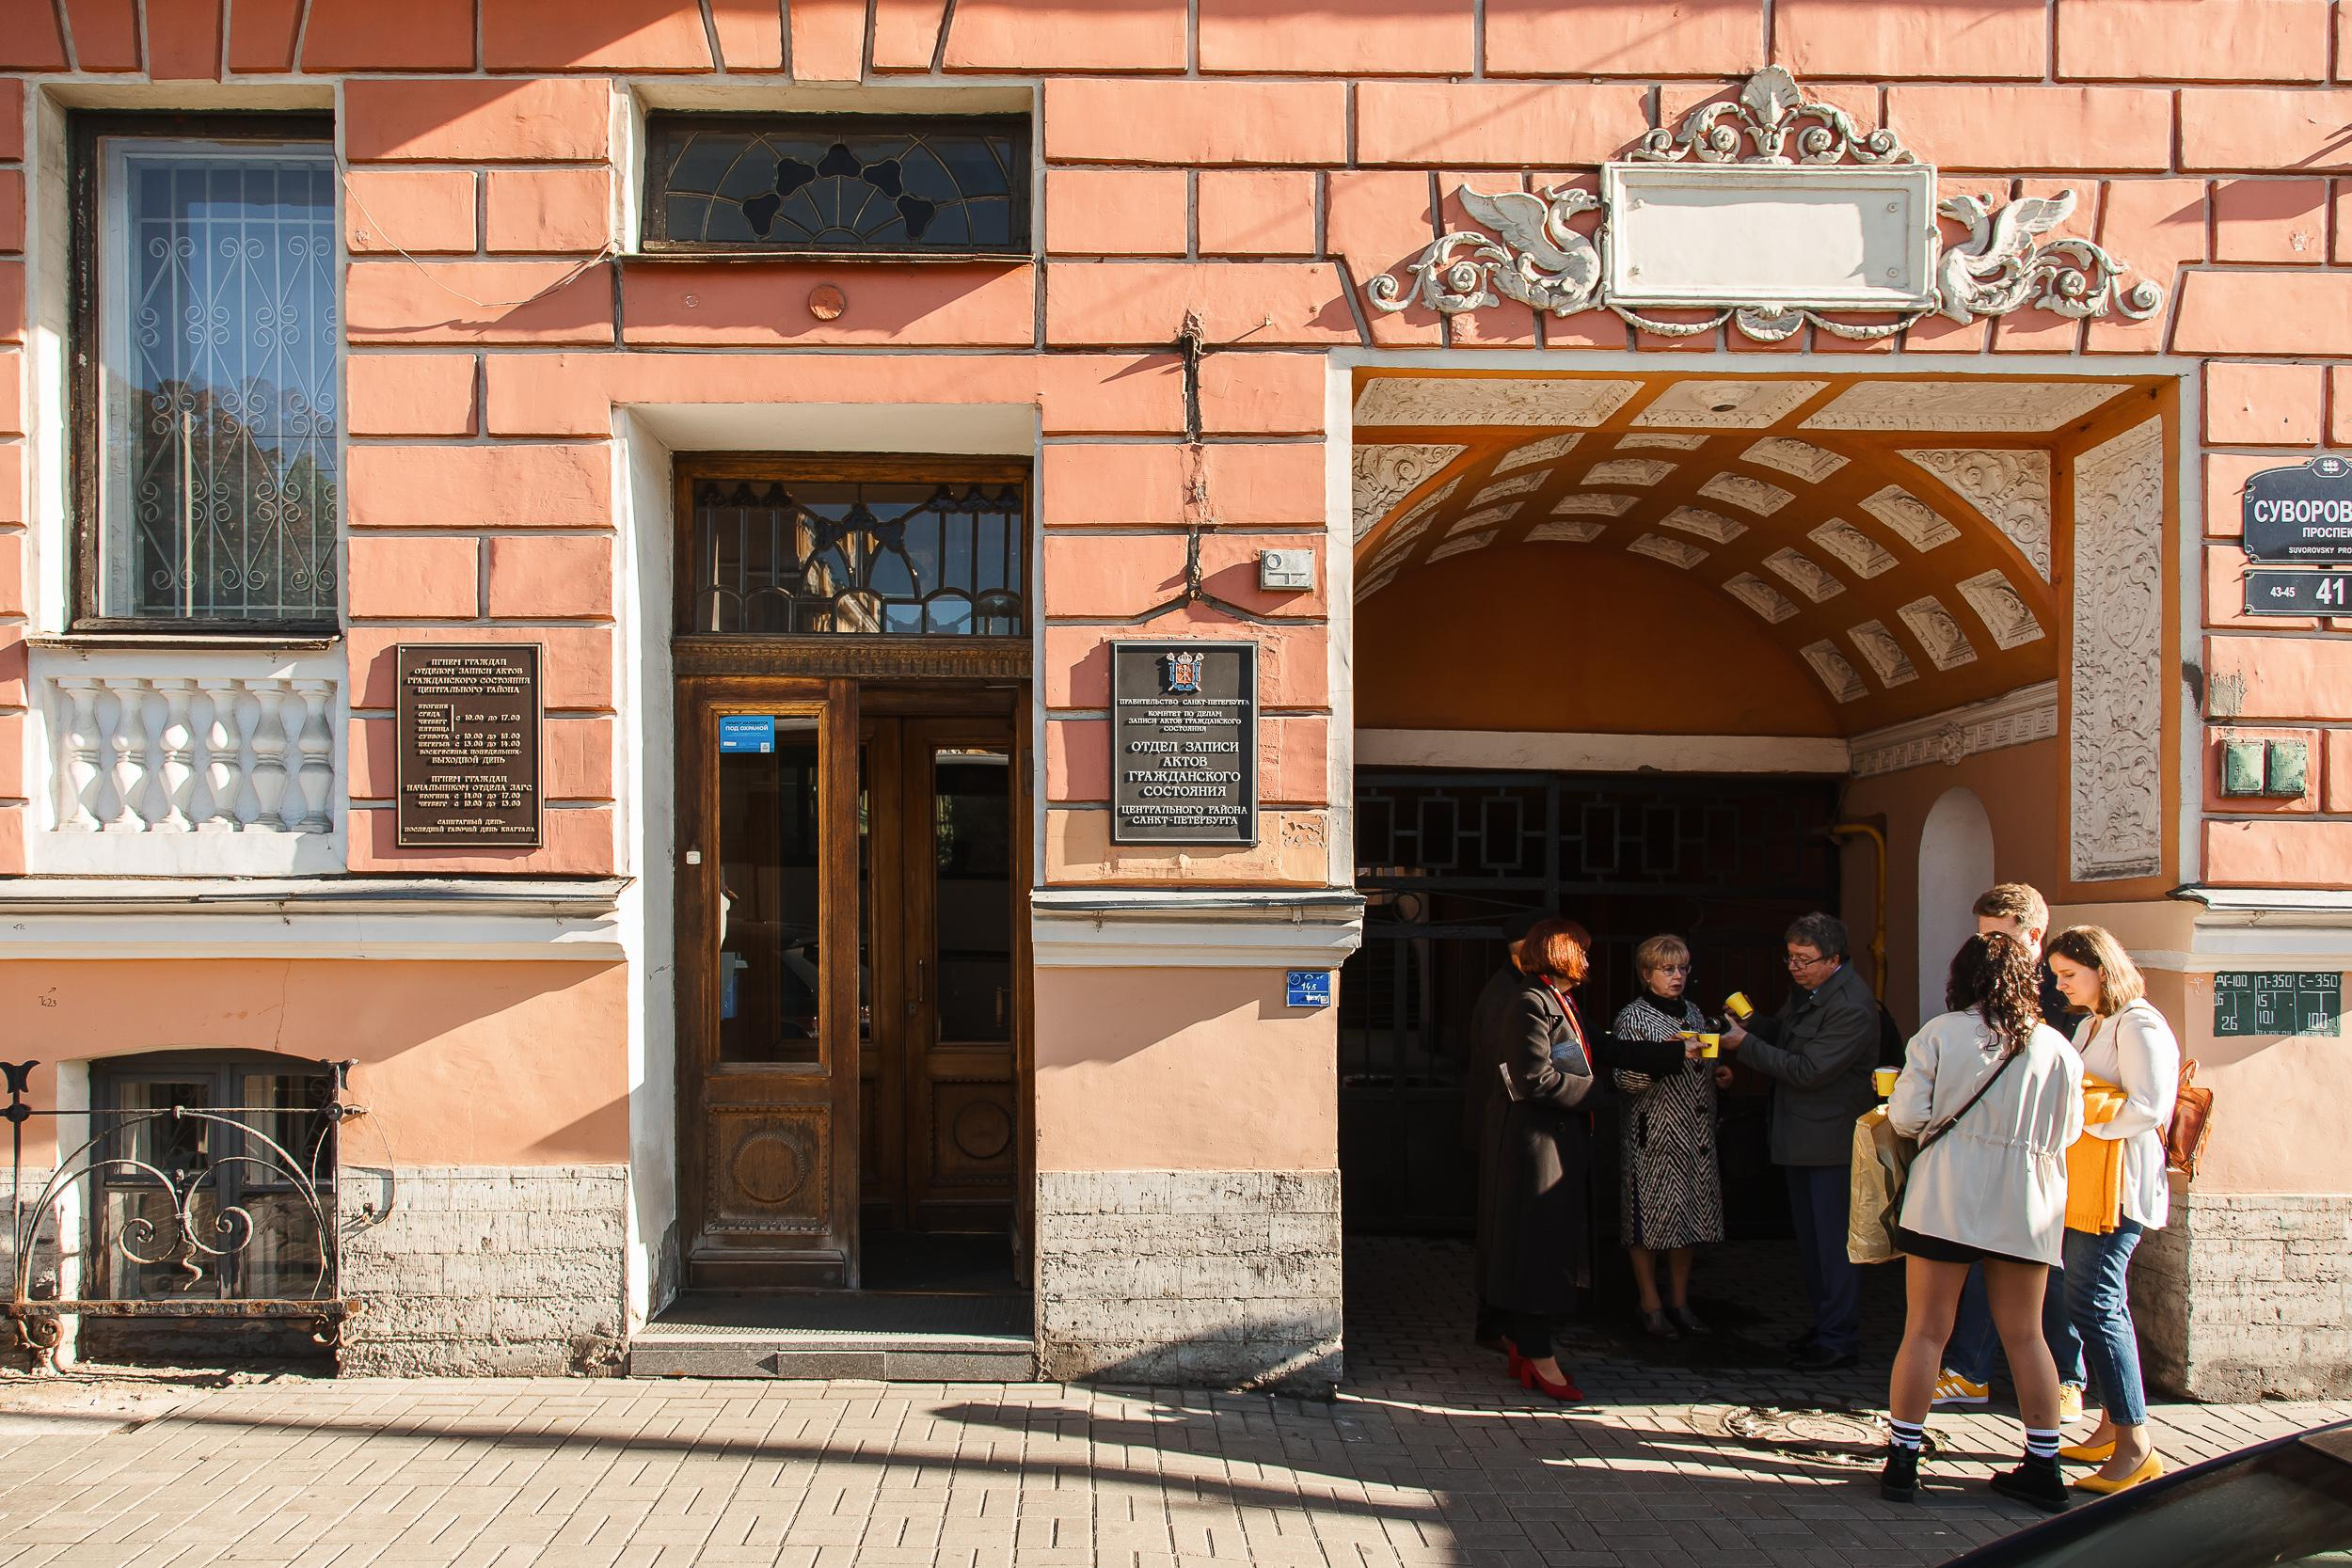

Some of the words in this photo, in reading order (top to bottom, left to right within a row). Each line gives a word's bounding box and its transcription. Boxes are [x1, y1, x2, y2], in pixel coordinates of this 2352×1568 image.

[2270, 587, 2296, 597] 43-45
[2316, 578, 2344, 604] 41
[418, 686, 483, 694] ЦЕНТРАЛЬНОГО
[487, 686, 519, 694] РАЙОНА
[1132, 742, 1178, 753] ОТДЕЛ
[1185, 742, 1239, 752] ЗАПИСИ
[432, 755, 479, 764] ВЫХОДНОЙ
[1163, 757, 1207, 767] АКТОВ
[1129, 771, 1240, 783] ГРАЖДАНСКОГО
[1144, 786, 1226, 797] СОСТОЯНИЯ
[1121, 806, 1203, 815] ЦЕНТРАЛЬНОГО
[1208, 805, 1248, 814] РАЙОНА
[1132, 816, 1237, 825] САНКТ-ПЕТЕРБУРГА
